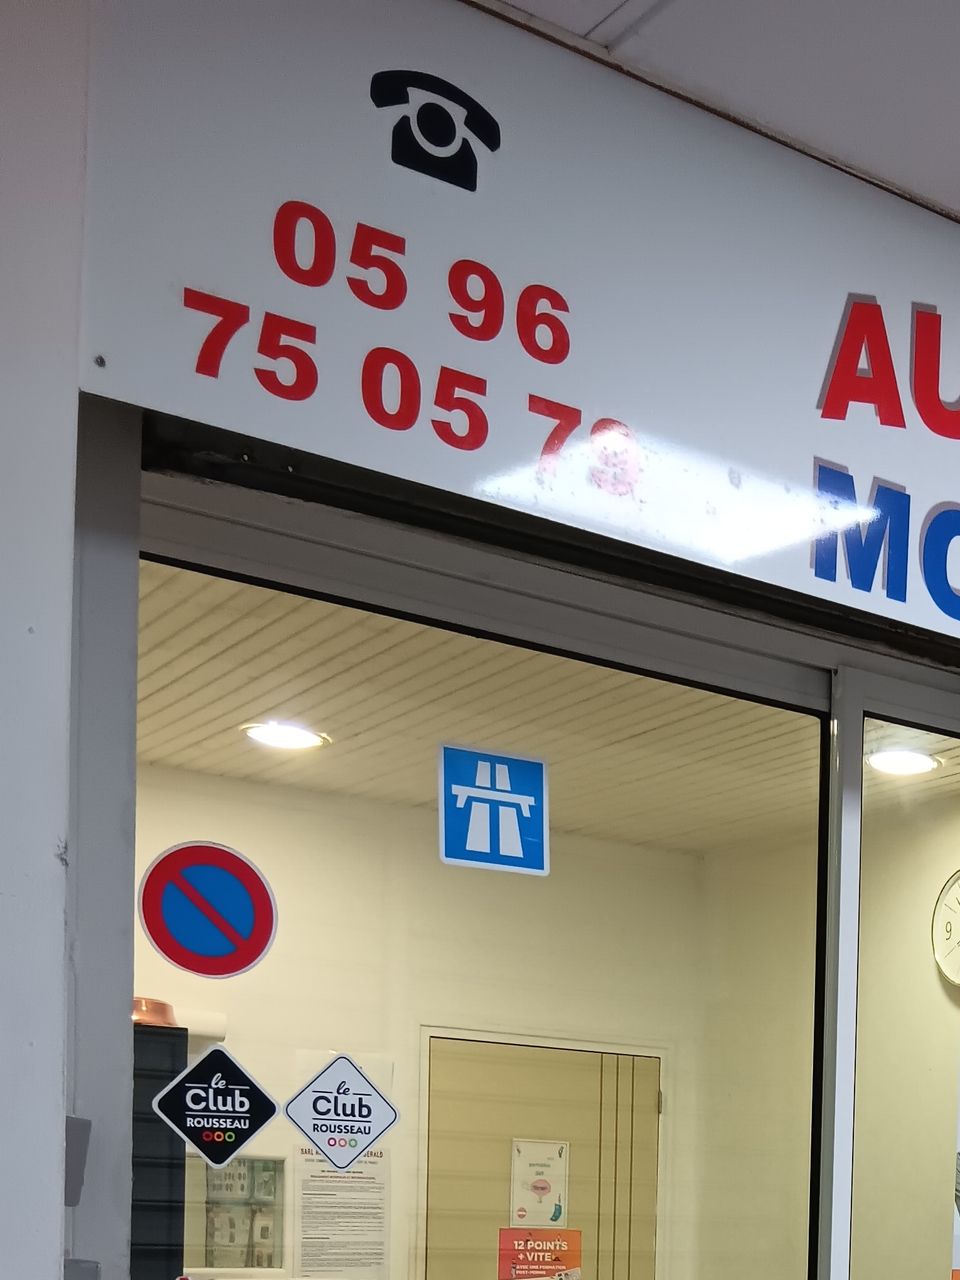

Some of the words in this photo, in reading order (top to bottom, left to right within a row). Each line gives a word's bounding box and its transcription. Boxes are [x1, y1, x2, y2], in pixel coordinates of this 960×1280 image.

[273, 200, 408, 310] 05
[448, 259, 570, 365] 96
[182, 287, 319, 401] 75
[361, 347, 489, 451] 05
[945, 921, 952, 941] 9
[211, 1073, 226, 1088] le
[336, 1080, 350, 1095] le
[185, 1088, 250, 1112] Club
[312, 1095, 372, 1118] Club
[186, 1117, 250, 1129] ROUSSEAU
[312, 1123, 371, 1135] ROUSSEAU
[513, 1241, 525, 1250] 12
[527, 1241, 568, 1251] POINTS
[526, 1252, 552, 1262] VITE
